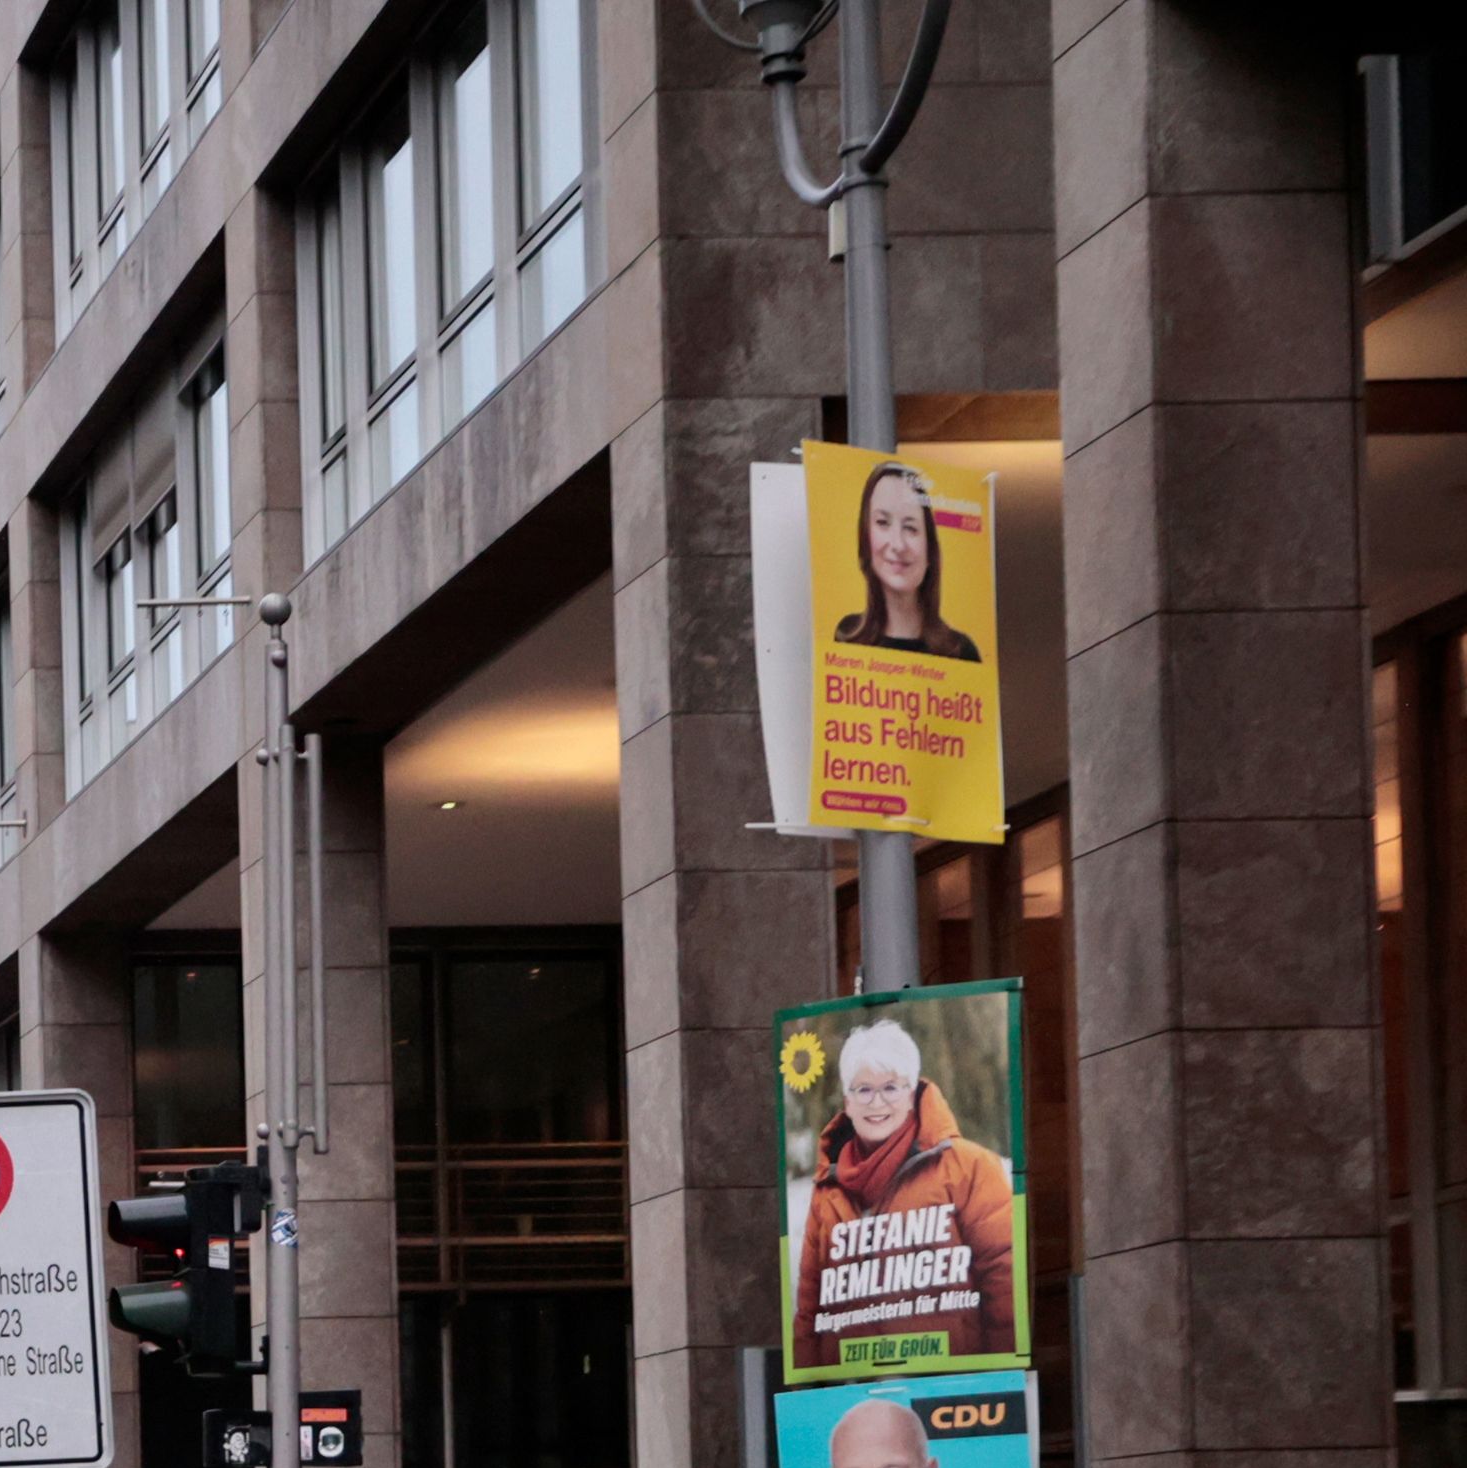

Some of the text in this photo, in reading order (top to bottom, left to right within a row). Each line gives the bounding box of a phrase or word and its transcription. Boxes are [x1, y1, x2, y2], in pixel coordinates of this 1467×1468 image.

[825, 652, 864, 669] Maren
[825, 674, 982, 724] Bildung heißt
[824, 718, 964, 758] aus Fehlern
[823, 750, 911, 786] lernen.
[830, 1203, 955, 1261] STEFANIE
[819, 1245, 972, 1306] REMLINGER
[814, 1289, 981, 1333] Bürgermeisterin für Mitte
[26, 1345, 84, 1376] Straße
[844, 1335, 944, 1363] ZEIT FÜR GRÜN.
[930, 1402, 1006, 1430] CDU
